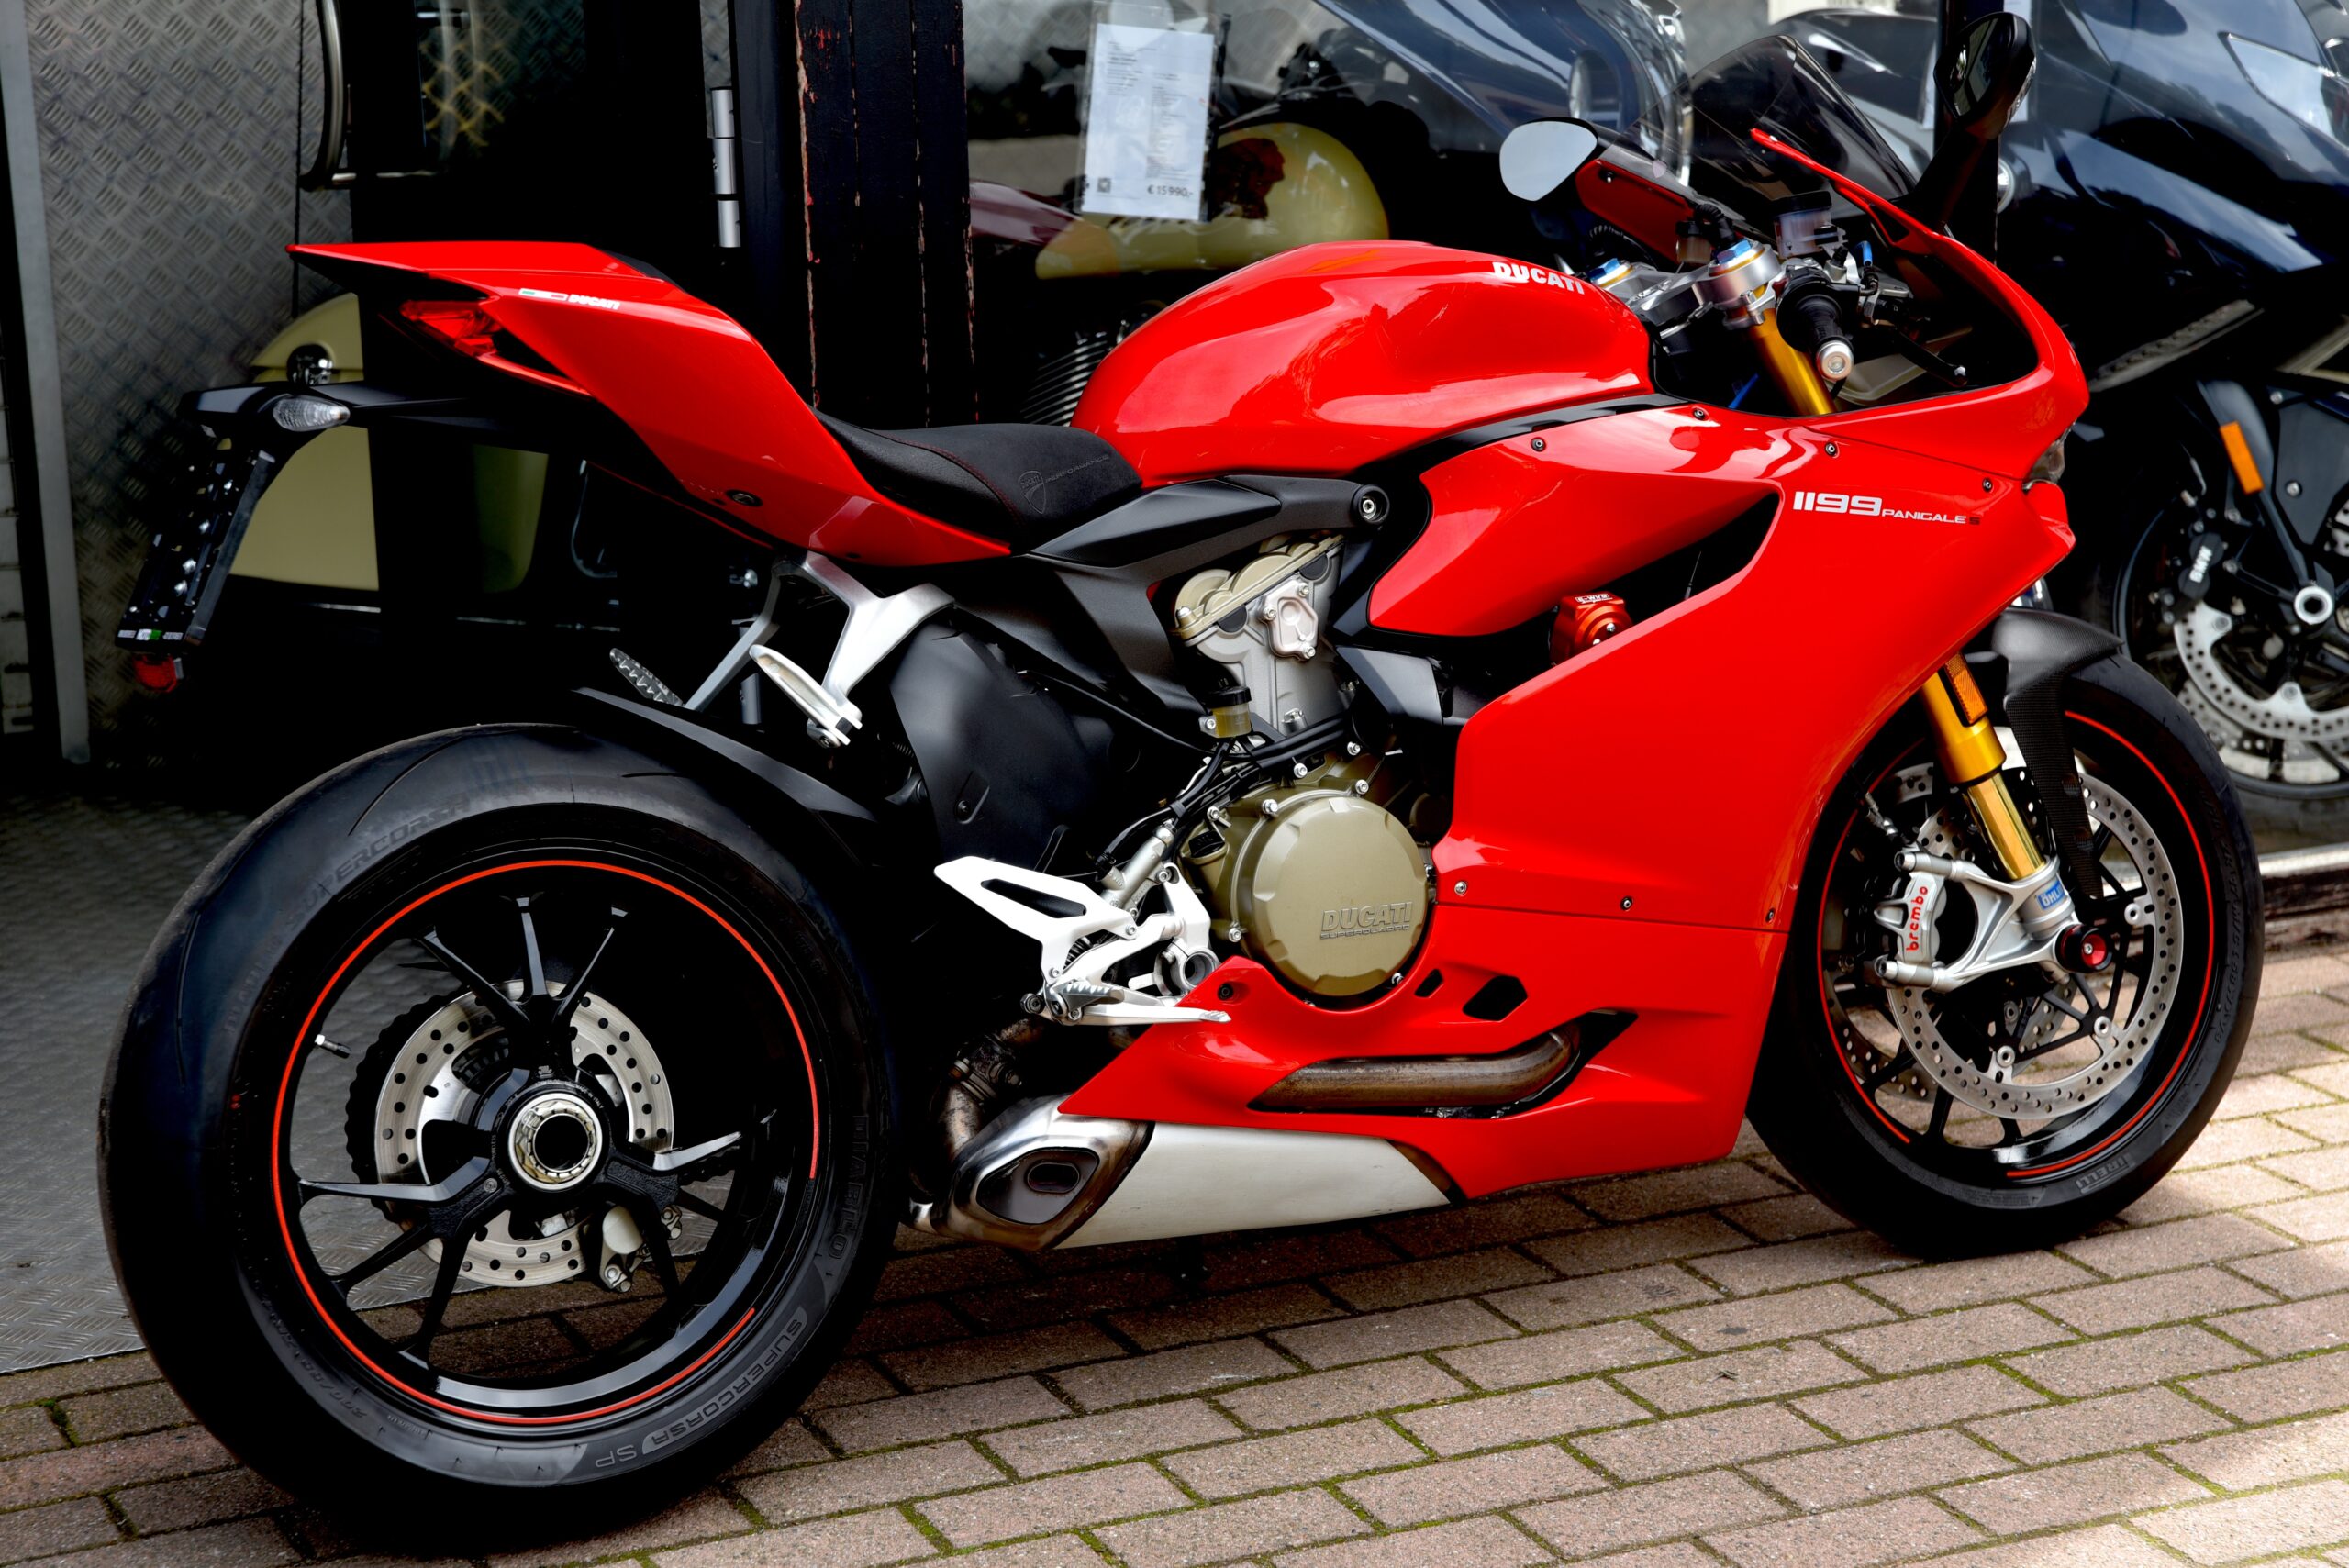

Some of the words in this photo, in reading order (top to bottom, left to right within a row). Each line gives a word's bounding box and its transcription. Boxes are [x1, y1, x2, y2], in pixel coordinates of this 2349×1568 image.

[1492, 261, 1585, 295] DUCATI
[569, 294, 620, 310] DUCATI
[1793, 491, 1882, 517] 1199
[1882, 508, 1966, 524] PANIGALE
[1321, 901, 1413, 931] DUCATI
[1906, 886, 1928, 951] brembo
[651, 1317, 804, 1446] SUPERCORSA
[595, 1444, 638, 1470] SP
